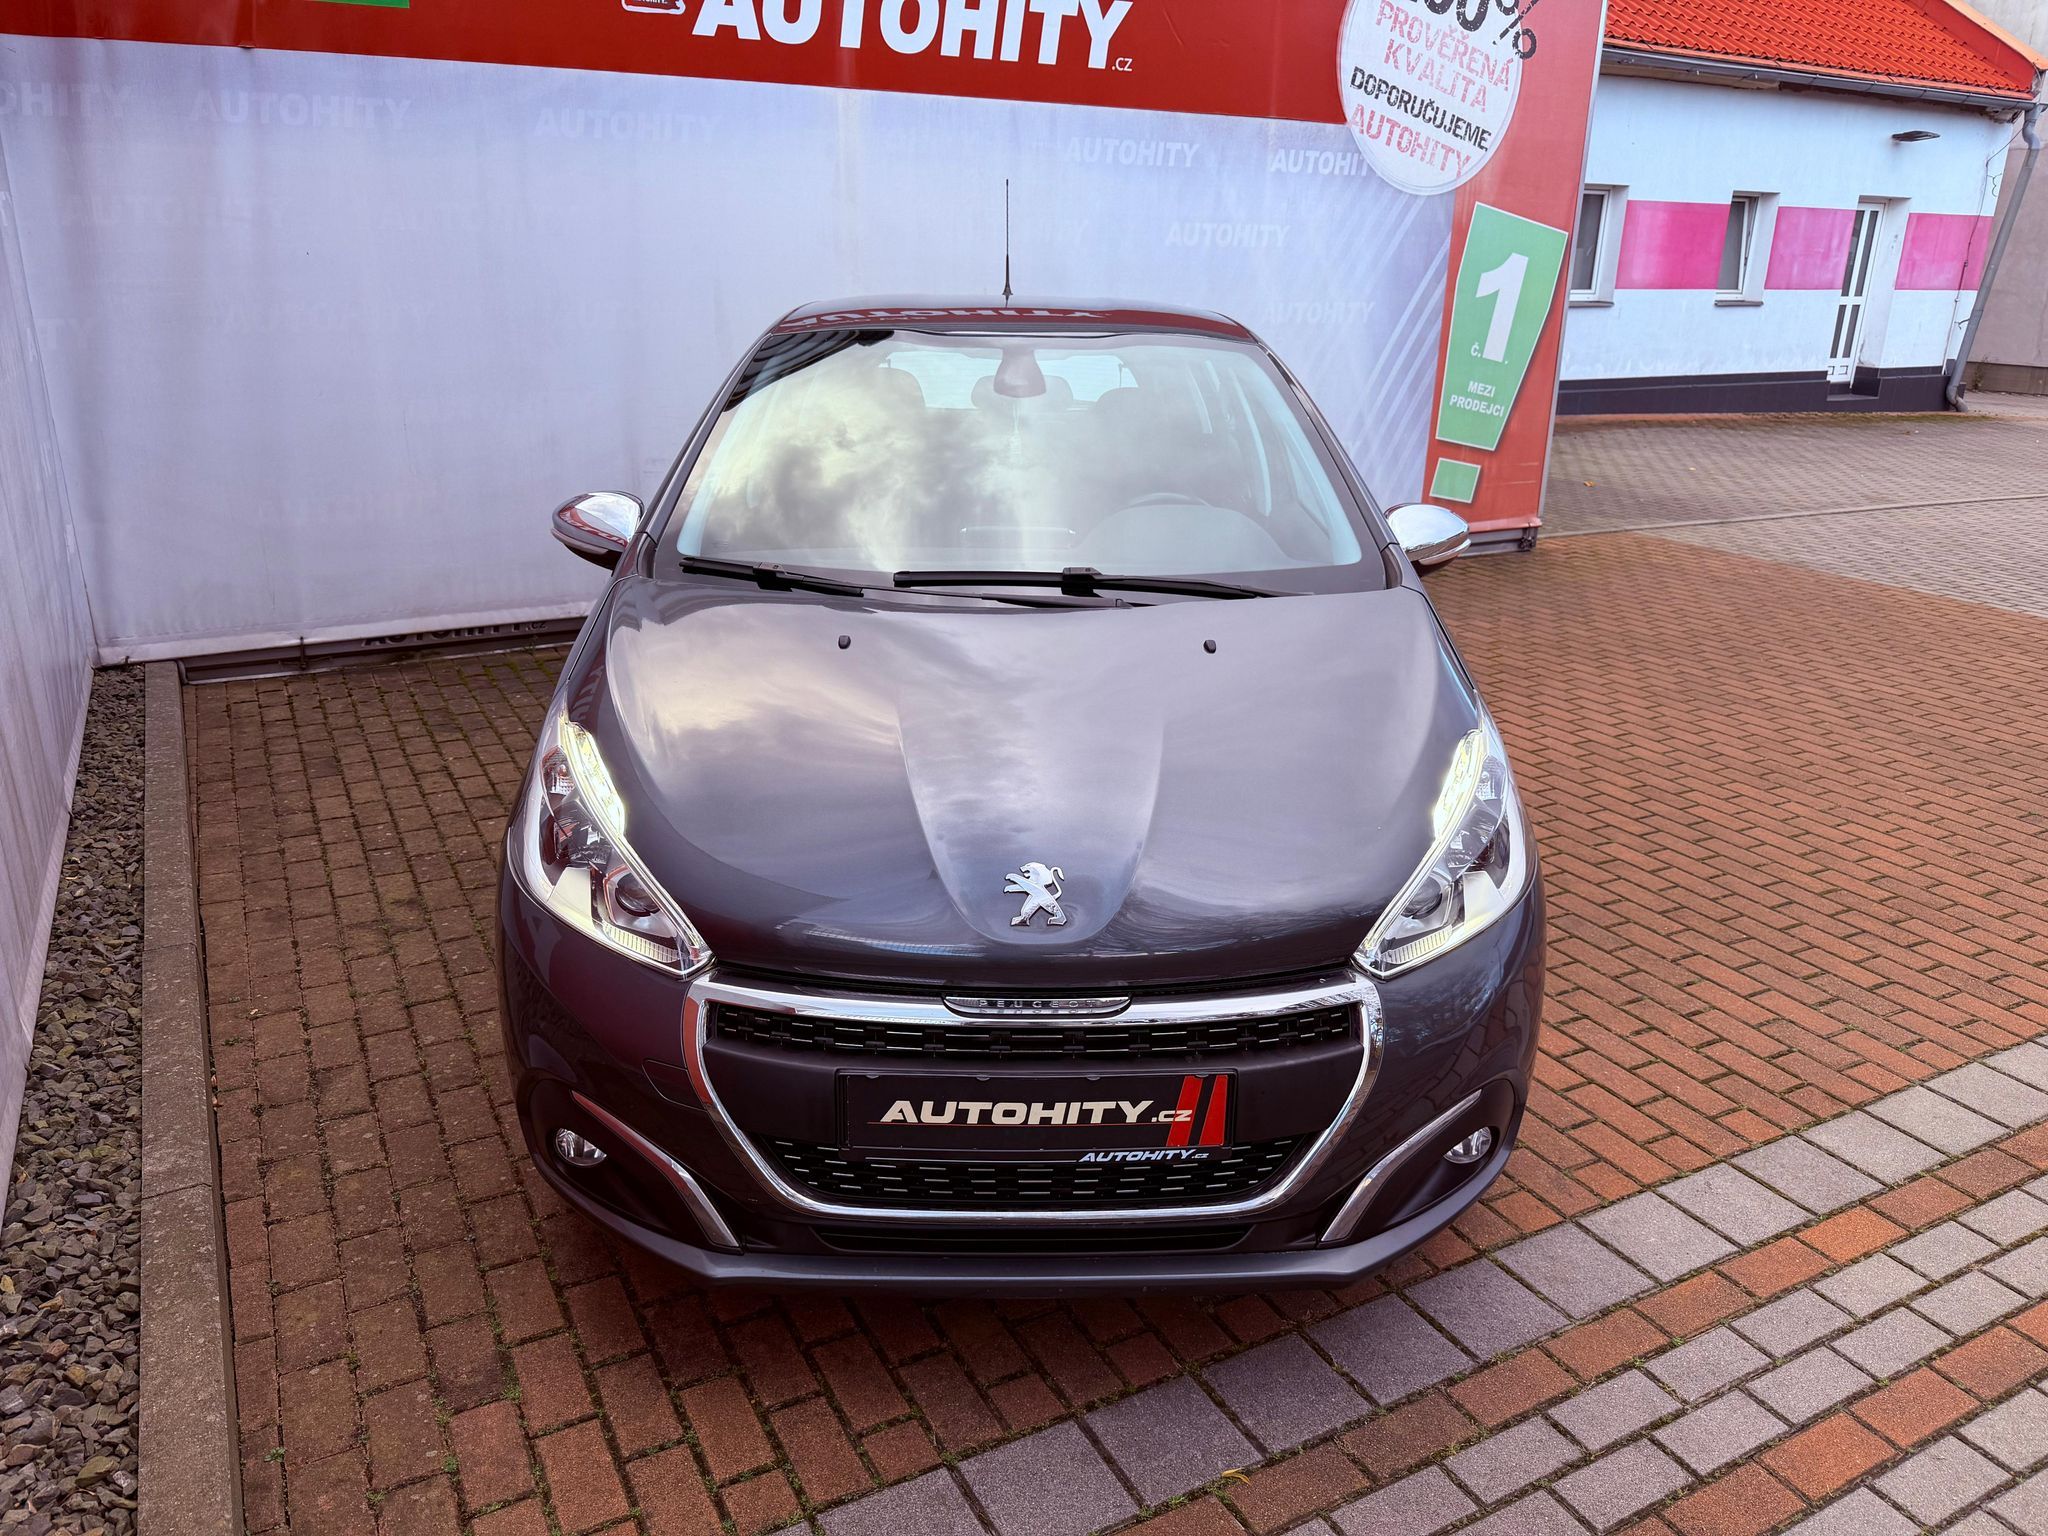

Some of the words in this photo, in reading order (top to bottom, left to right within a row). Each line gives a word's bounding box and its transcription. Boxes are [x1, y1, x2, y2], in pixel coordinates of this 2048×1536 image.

[1375, 0, 1514, 91] PROVĚŘENÁ
[1384, 38, 1487, 112] KVALITA
[1350, 65, 1492, 152] DOPORUČUJEME
[1067, 136, 1200, 168] AUTOHITY
[1352, 103, 1472, 177] AUTOHITY
[1165, 222, 1290, 248] AUTOHITY
[1450, 394, 1505, 417] PRODEJCI
[1467, 380, 1496, 398] MEZI
